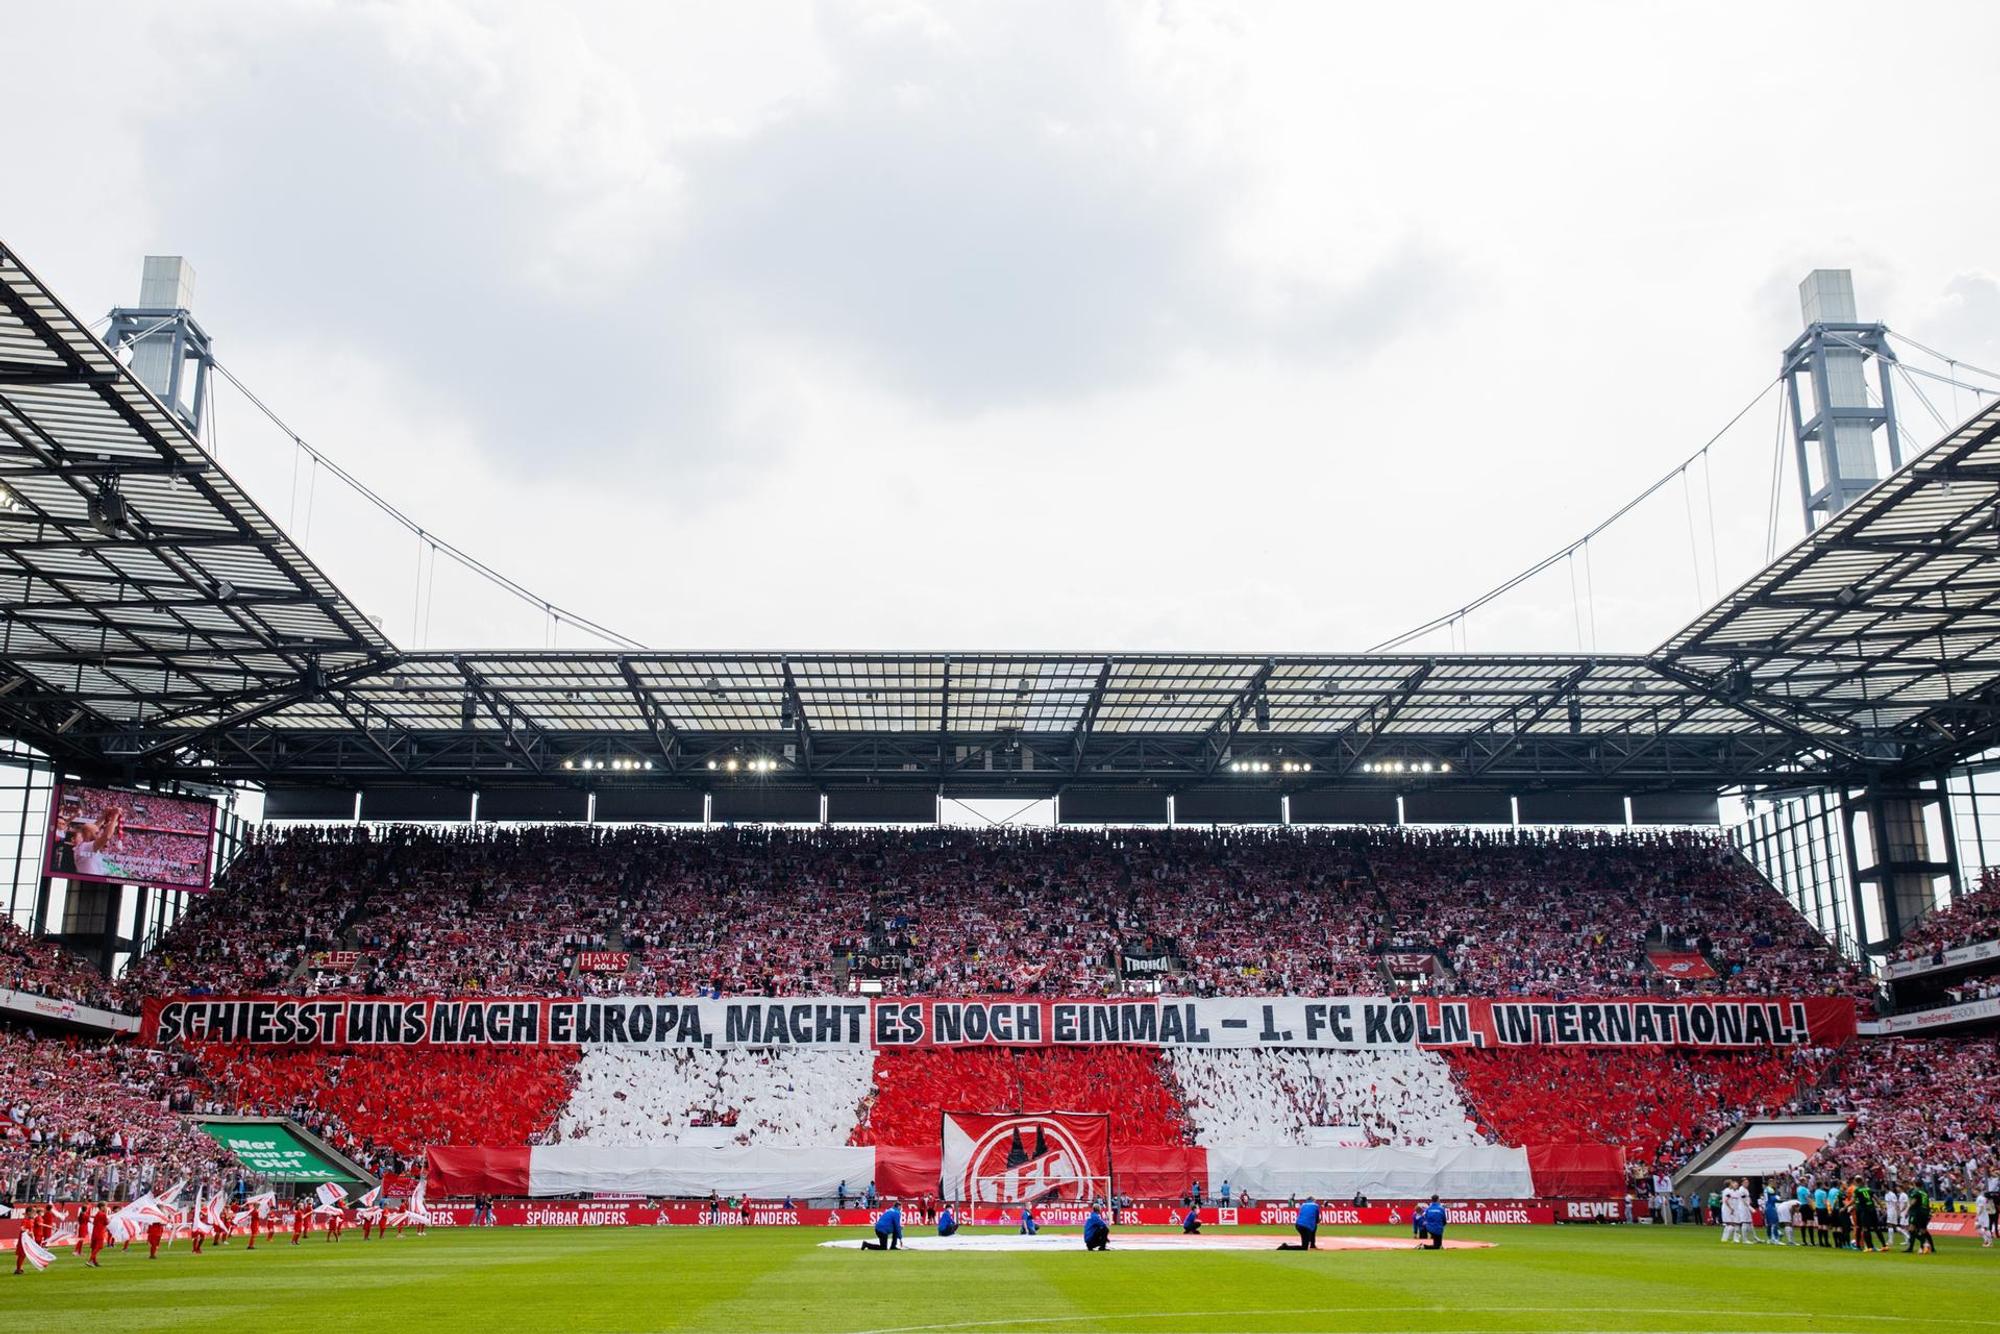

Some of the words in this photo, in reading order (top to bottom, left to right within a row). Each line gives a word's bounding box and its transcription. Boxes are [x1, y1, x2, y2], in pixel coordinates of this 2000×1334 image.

[581, 953, 630, 966] HAWKS
[594, 962, 618, 970] KÖLN
[1124, 956, 1168, 972] TROIKA
[158, 1002, 342, 1044] SCHIESST
[346, 1001, 427, 1044] UNS
[430, 1002, 540, 1044] NACH
[549, 1002, 713, 1049] EUROPA,
[726, 1004, 866, 1043] MACHT
[876, 1003, 925, 1045] ES
[933, 1003, 1042, 1044] NOCH
[1259, 1005, 1293, 1041] 1.
[1305, 1004, 1354, 1042] FC
[1365, 996, 1485, 1048] KÖLN,
[1491, 1002, 1811, 1045] INTERNATIONAL!
[228, 1139, 276, 1149] Mer
[526, 1209, 578, 1225] SPÜRBAR
[582, 1211, 629, 1225] ANDERS.
[1260, 1208, 1297, 1224] SPÜRB
[1319, 1210, 1362, 1224] NDERS.
[1444, 1208, 1482, 1224] ÜRBAR
[1484, 1210, 1531, 1224] ANDERS.
[1567, 1202, 1620, 1217] REWE
[753, 1211, 800, 1224] ANDERS.
